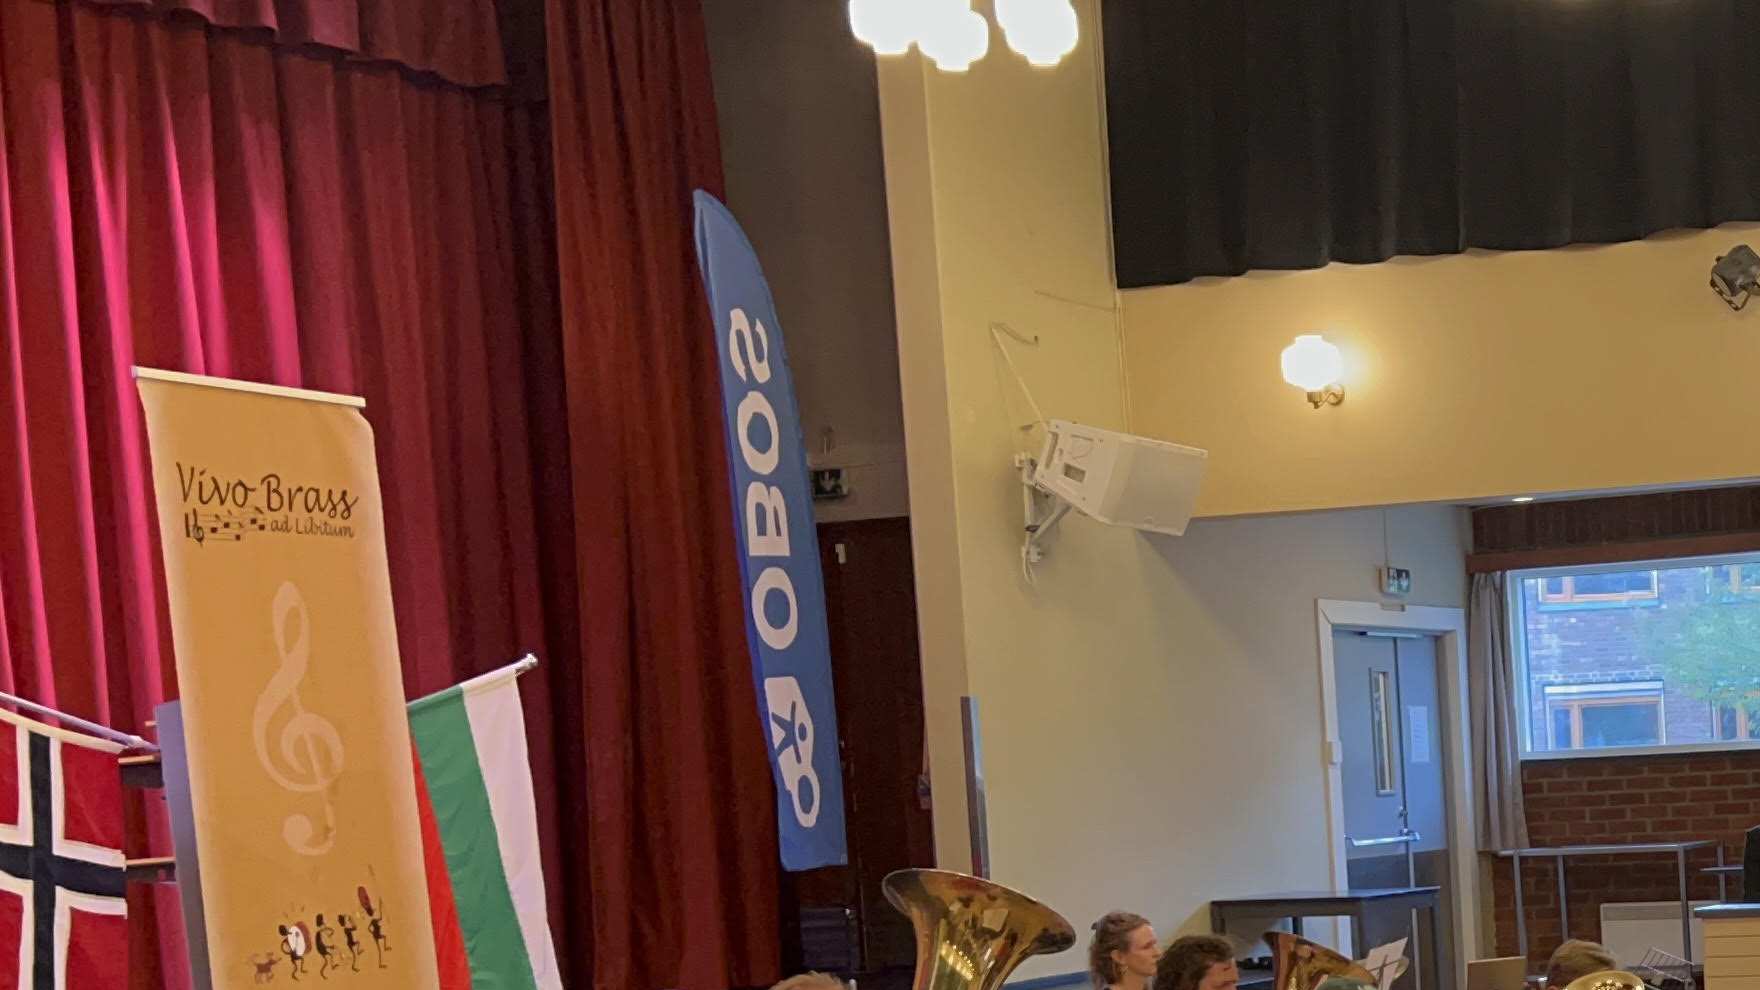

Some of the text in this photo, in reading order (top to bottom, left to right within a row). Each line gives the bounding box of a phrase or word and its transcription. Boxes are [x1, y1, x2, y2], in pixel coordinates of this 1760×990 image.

[175, 461, 360, 520] Vivo Brass
[270, 514, 355, 539] ad Libitum
